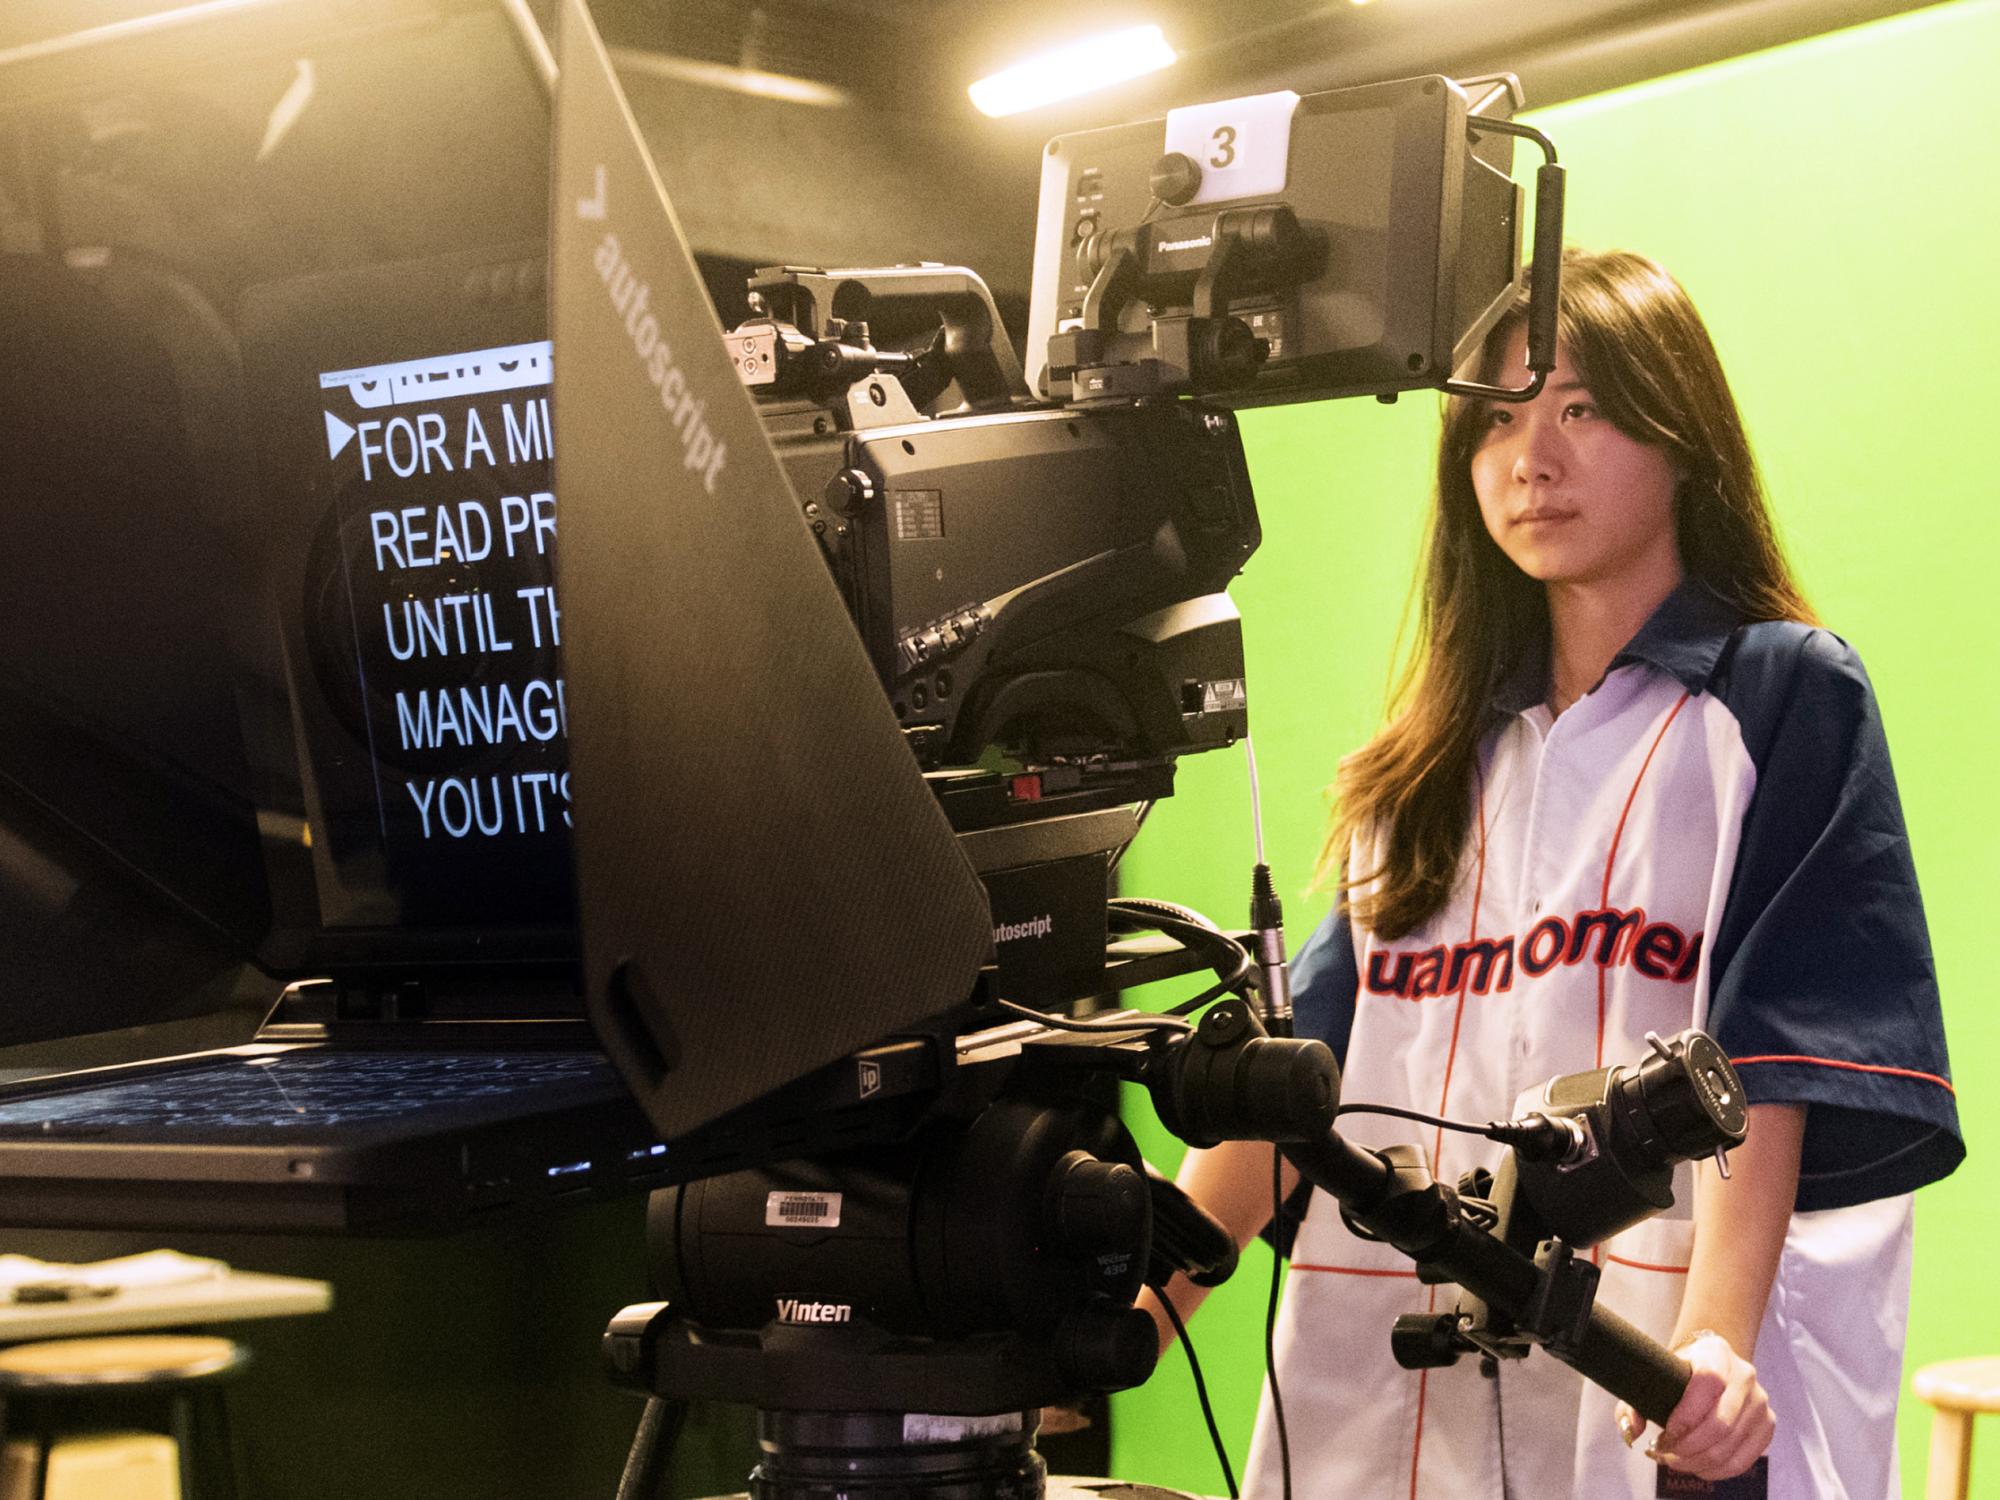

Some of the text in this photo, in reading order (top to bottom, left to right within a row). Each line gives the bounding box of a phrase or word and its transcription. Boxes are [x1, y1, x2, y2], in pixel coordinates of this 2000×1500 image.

[1210, 125, 1237, 169] 3
[1158, 235, 1211, 252] Panasonic
[594, 233, 727, 495] autoscript
[358, 398, 554, 481] FOR A MI
[371, 492, 556, 571] READ PR
[384, 593, 513, 661] UNTIL
[406, 776, 502, 839] YOU
[776, 1298, 852, 1323] Vinten
